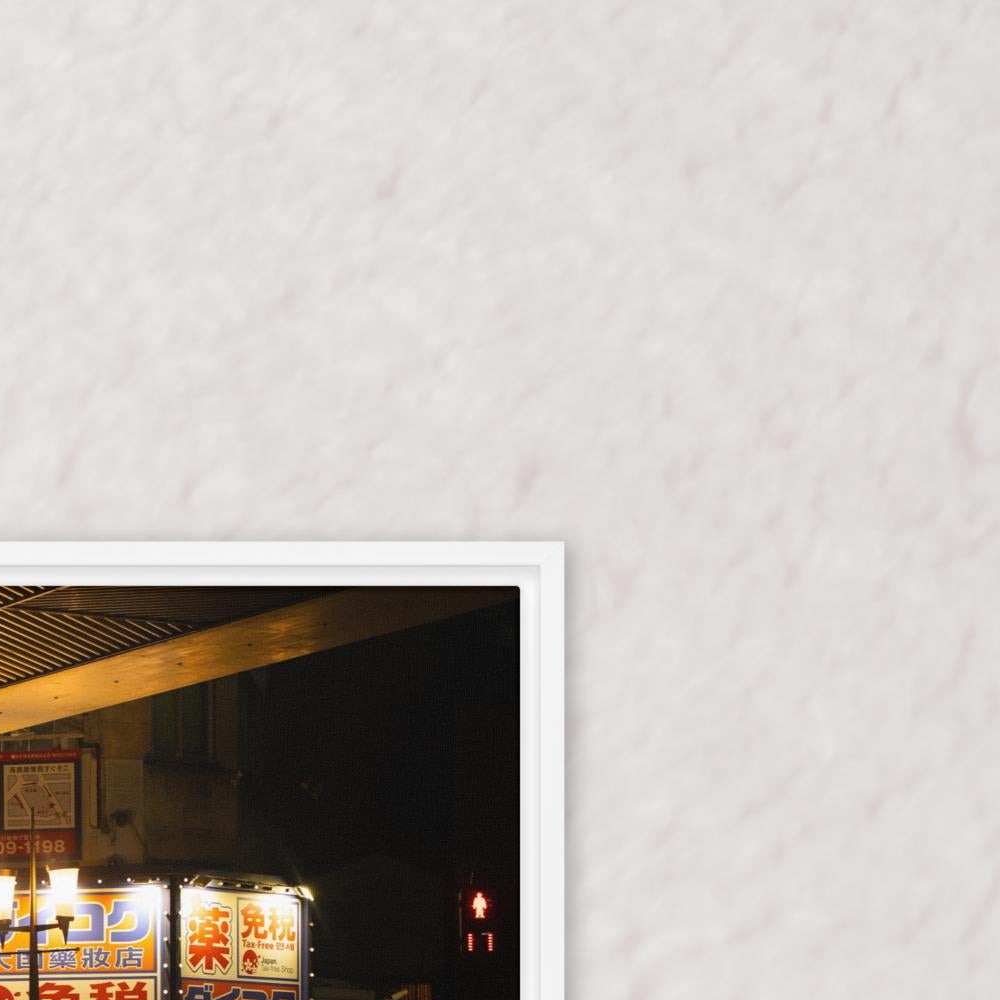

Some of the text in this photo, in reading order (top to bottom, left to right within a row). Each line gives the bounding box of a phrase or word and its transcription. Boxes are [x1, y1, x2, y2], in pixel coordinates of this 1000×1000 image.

[188, 906, 231, 971] 薬
[240, 903, 296, 942] 免税
[242, 939, 274, 951] Tax-Free
